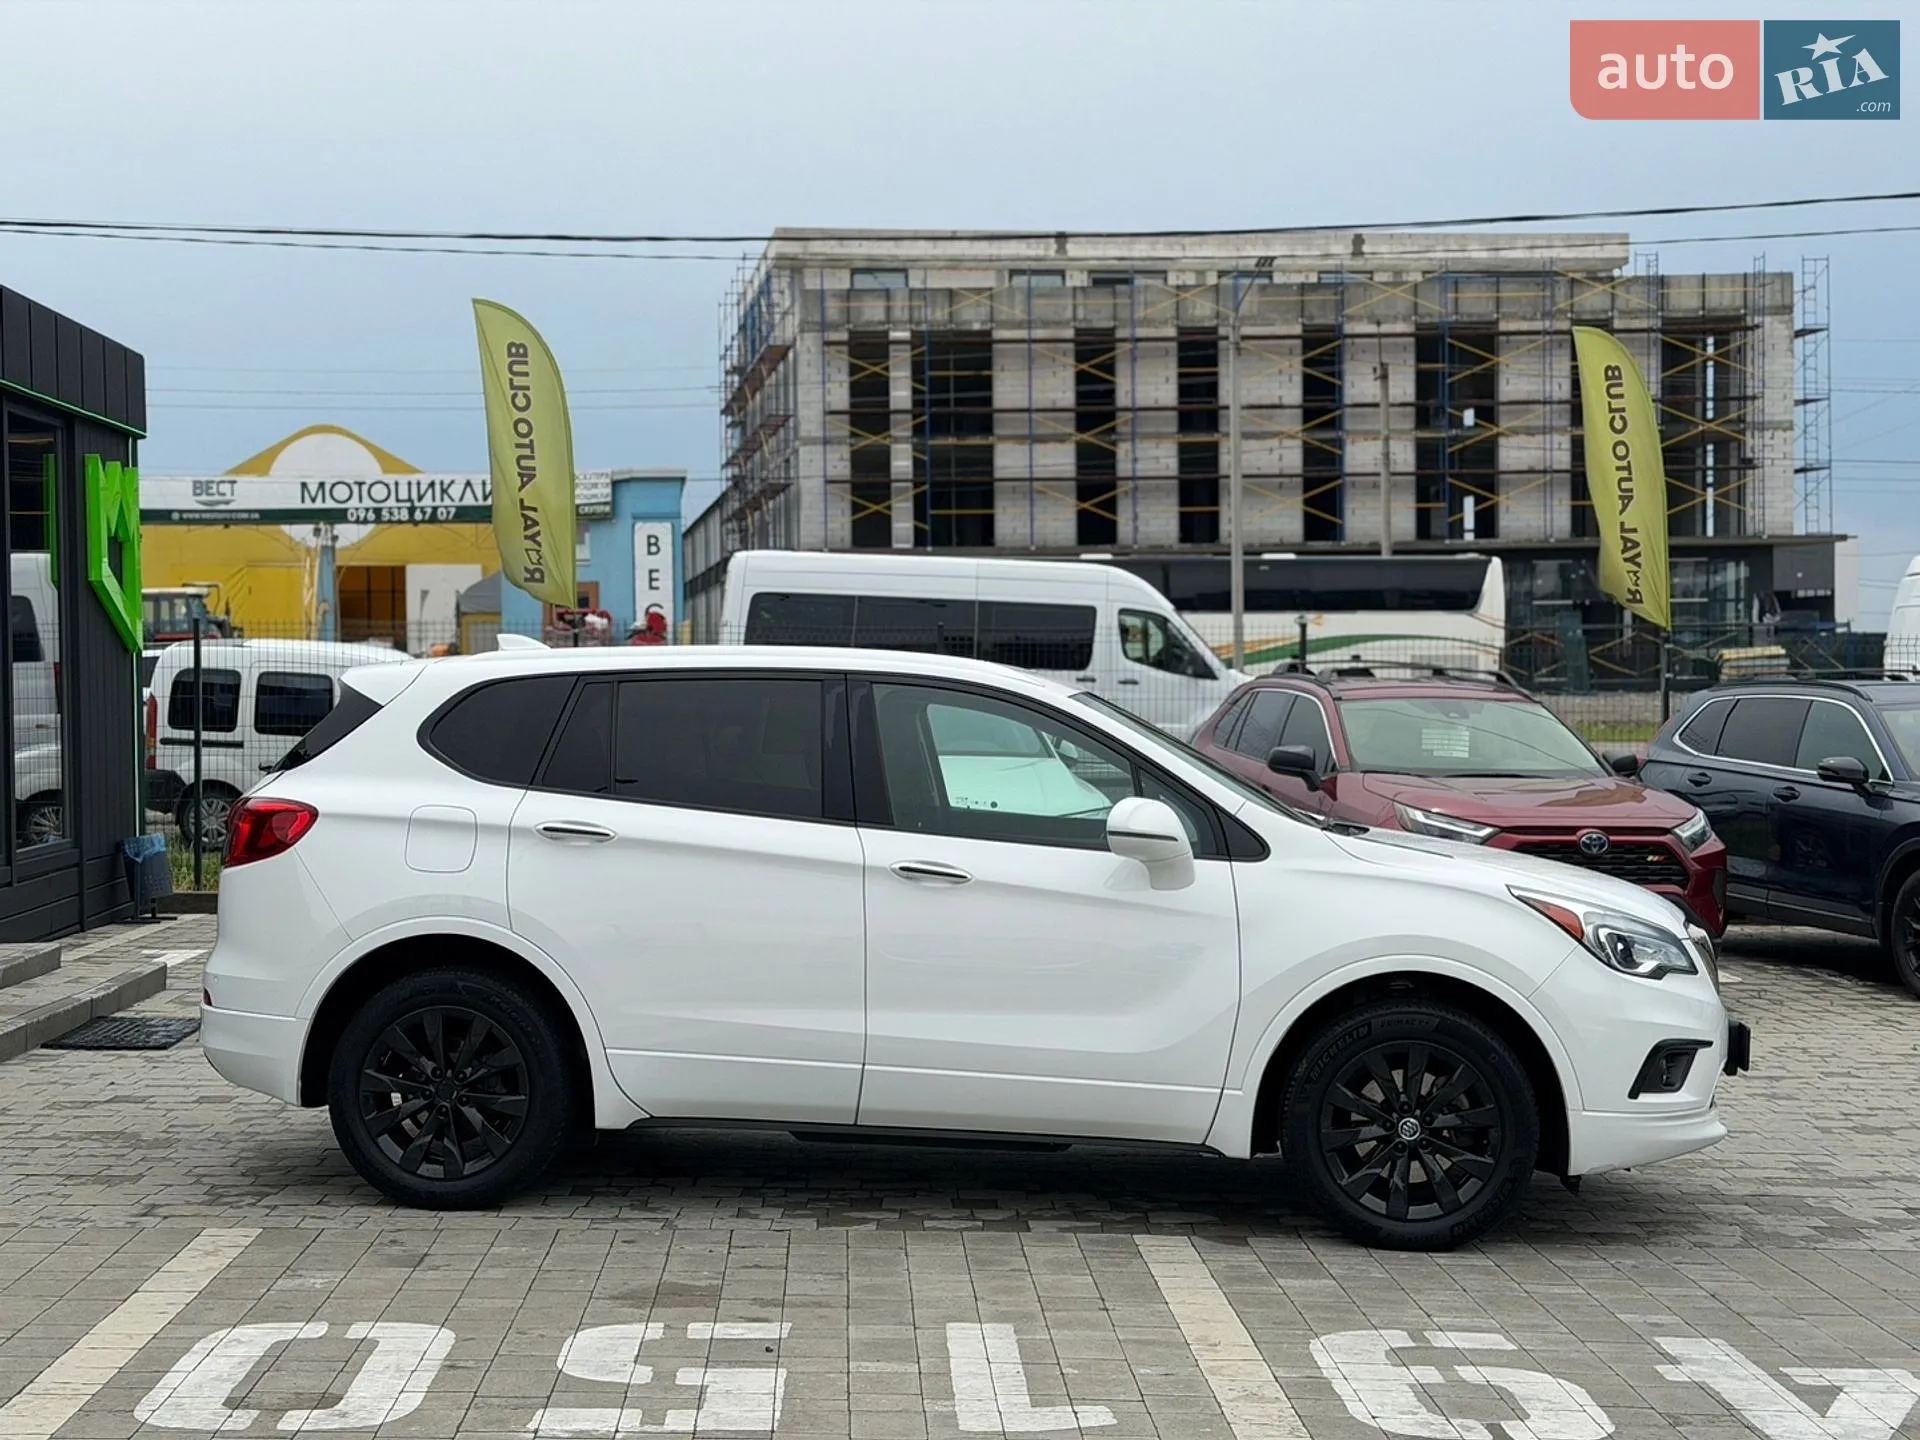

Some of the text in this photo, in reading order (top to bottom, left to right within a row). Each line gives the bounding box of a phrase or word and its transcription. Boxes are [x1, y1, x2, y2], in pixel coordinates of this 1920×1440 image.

[192, 480, 238, 497] ВЕСТ
[346, 507, 457, 522] 096 538 67 07
